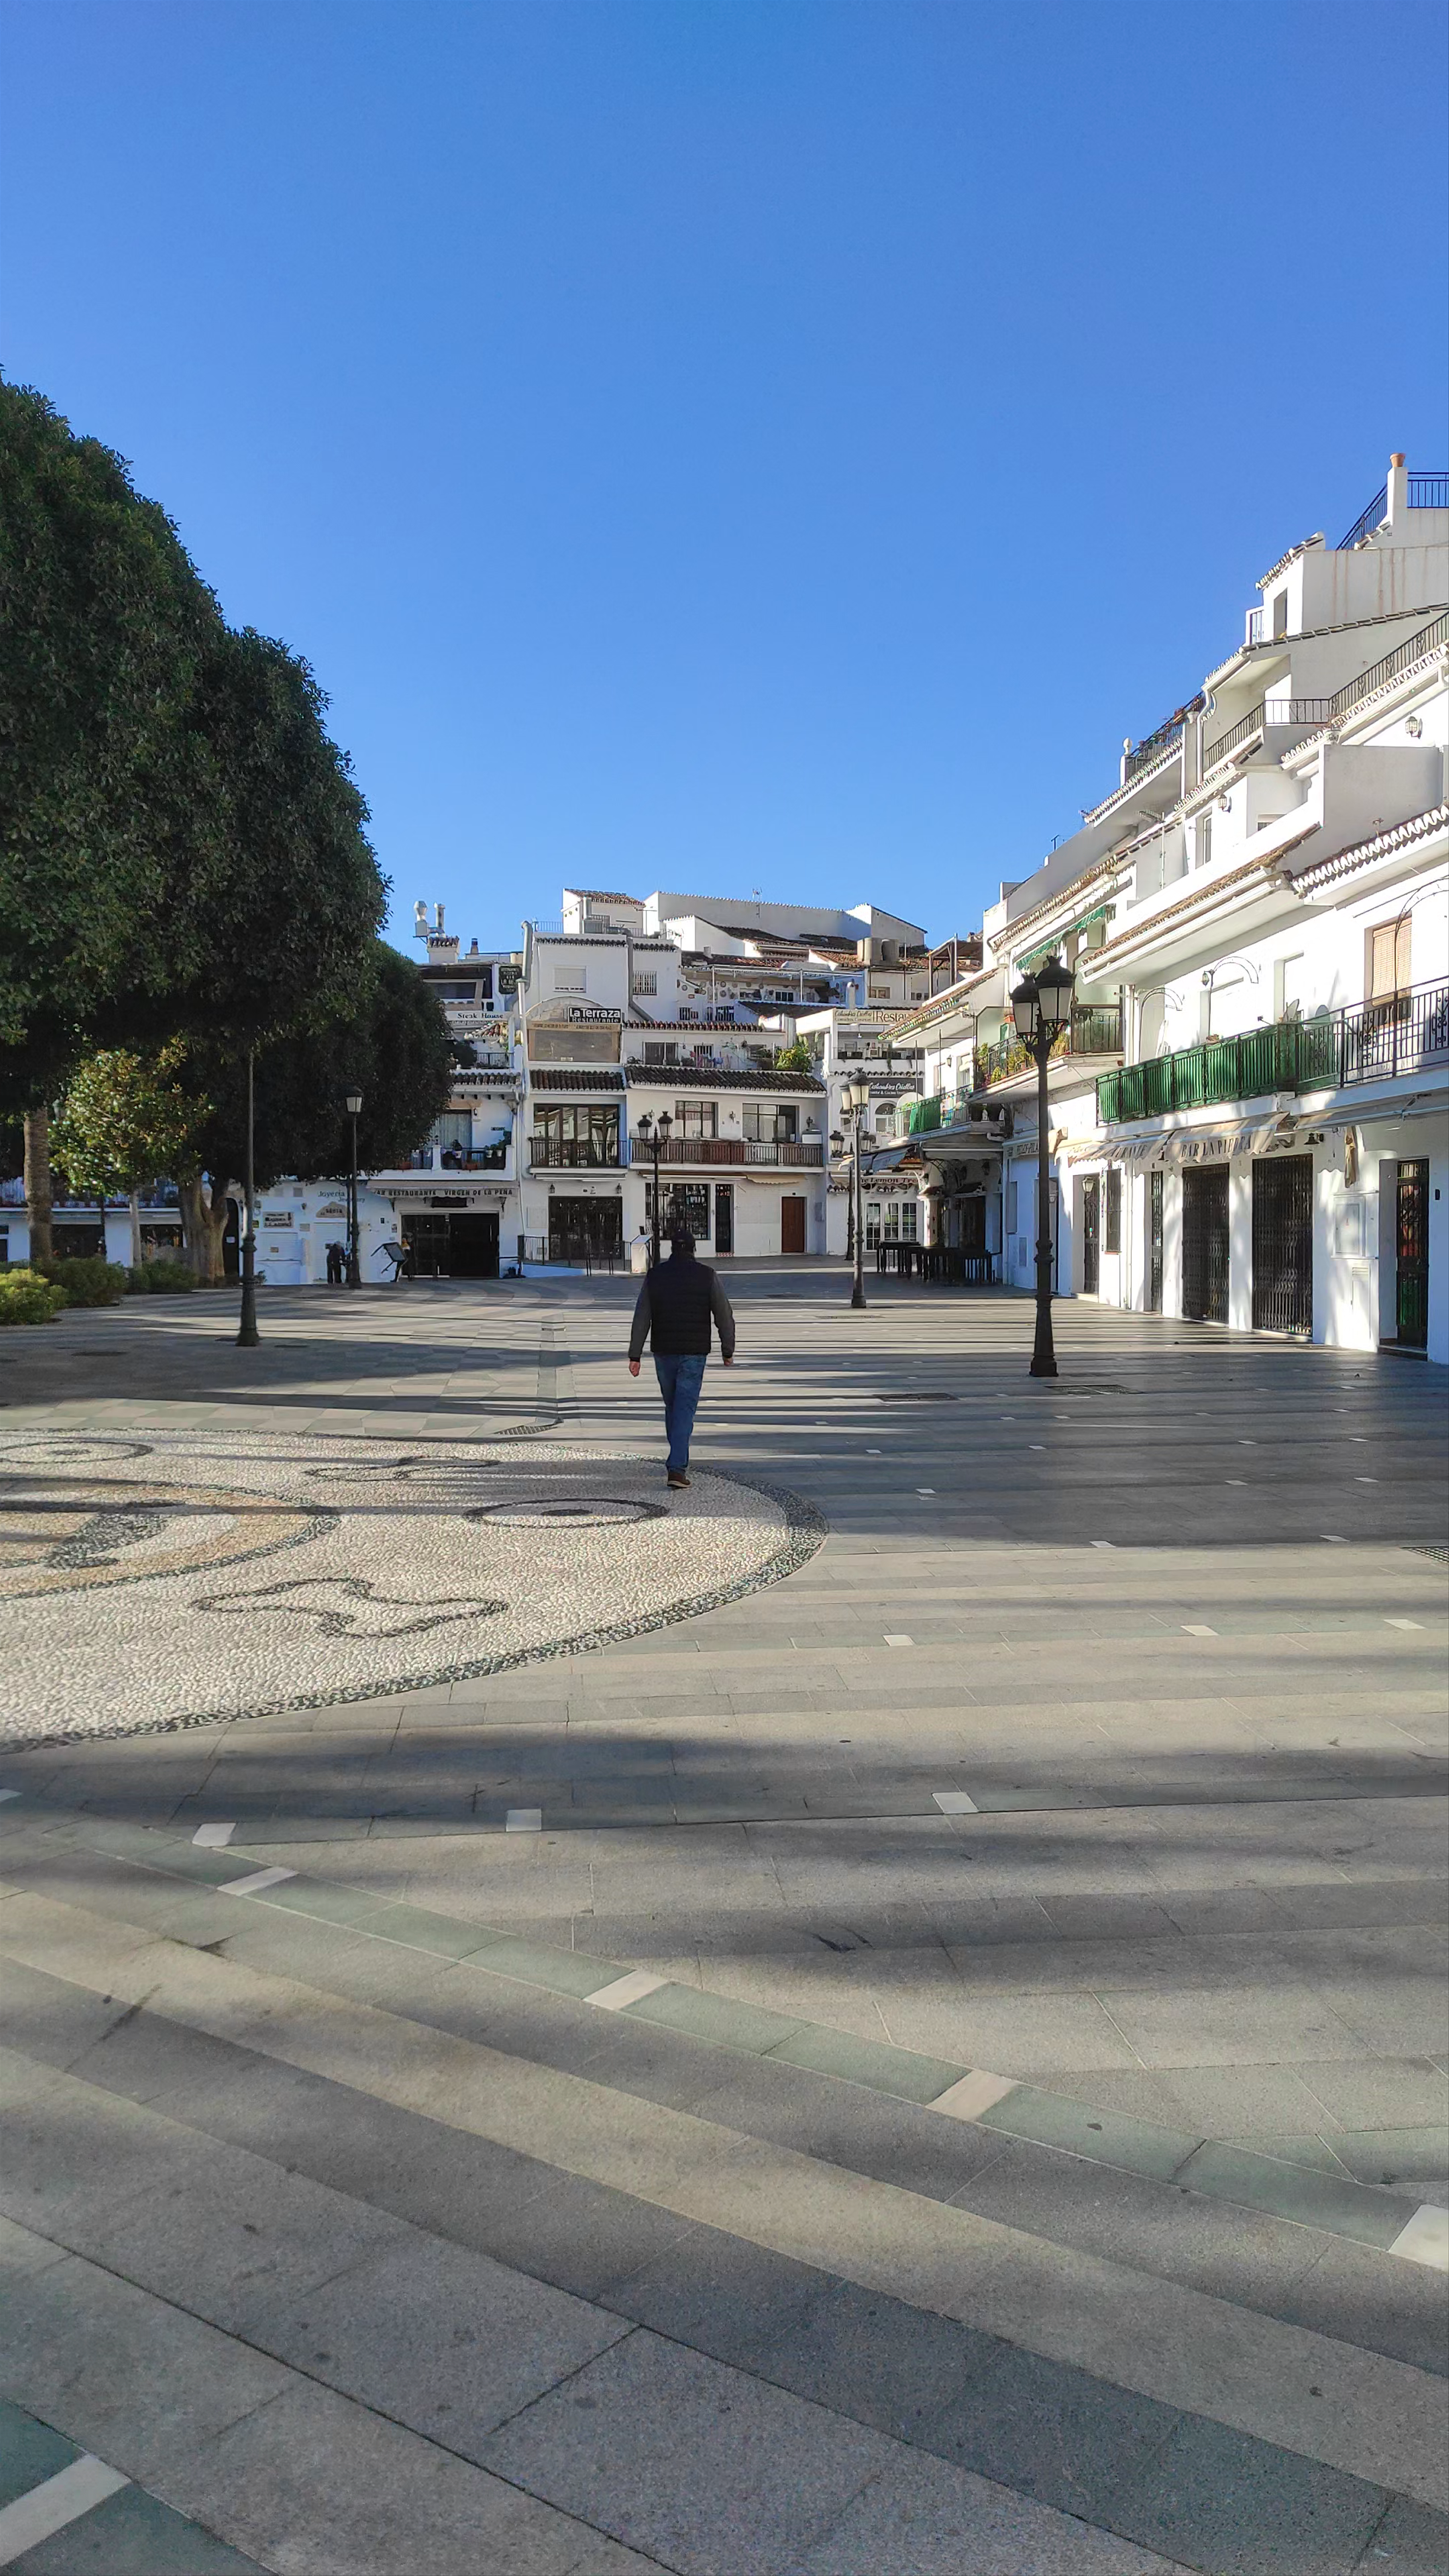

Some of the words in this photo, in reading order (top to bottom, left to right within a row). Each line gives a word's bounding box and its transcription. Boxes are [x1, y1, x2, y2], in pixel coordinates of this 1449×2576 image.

[569, 1008, 580, 1017] La
[580, 1008, 620, 1018] Terraza
[1203, 1142, 1214, 1156] LA
